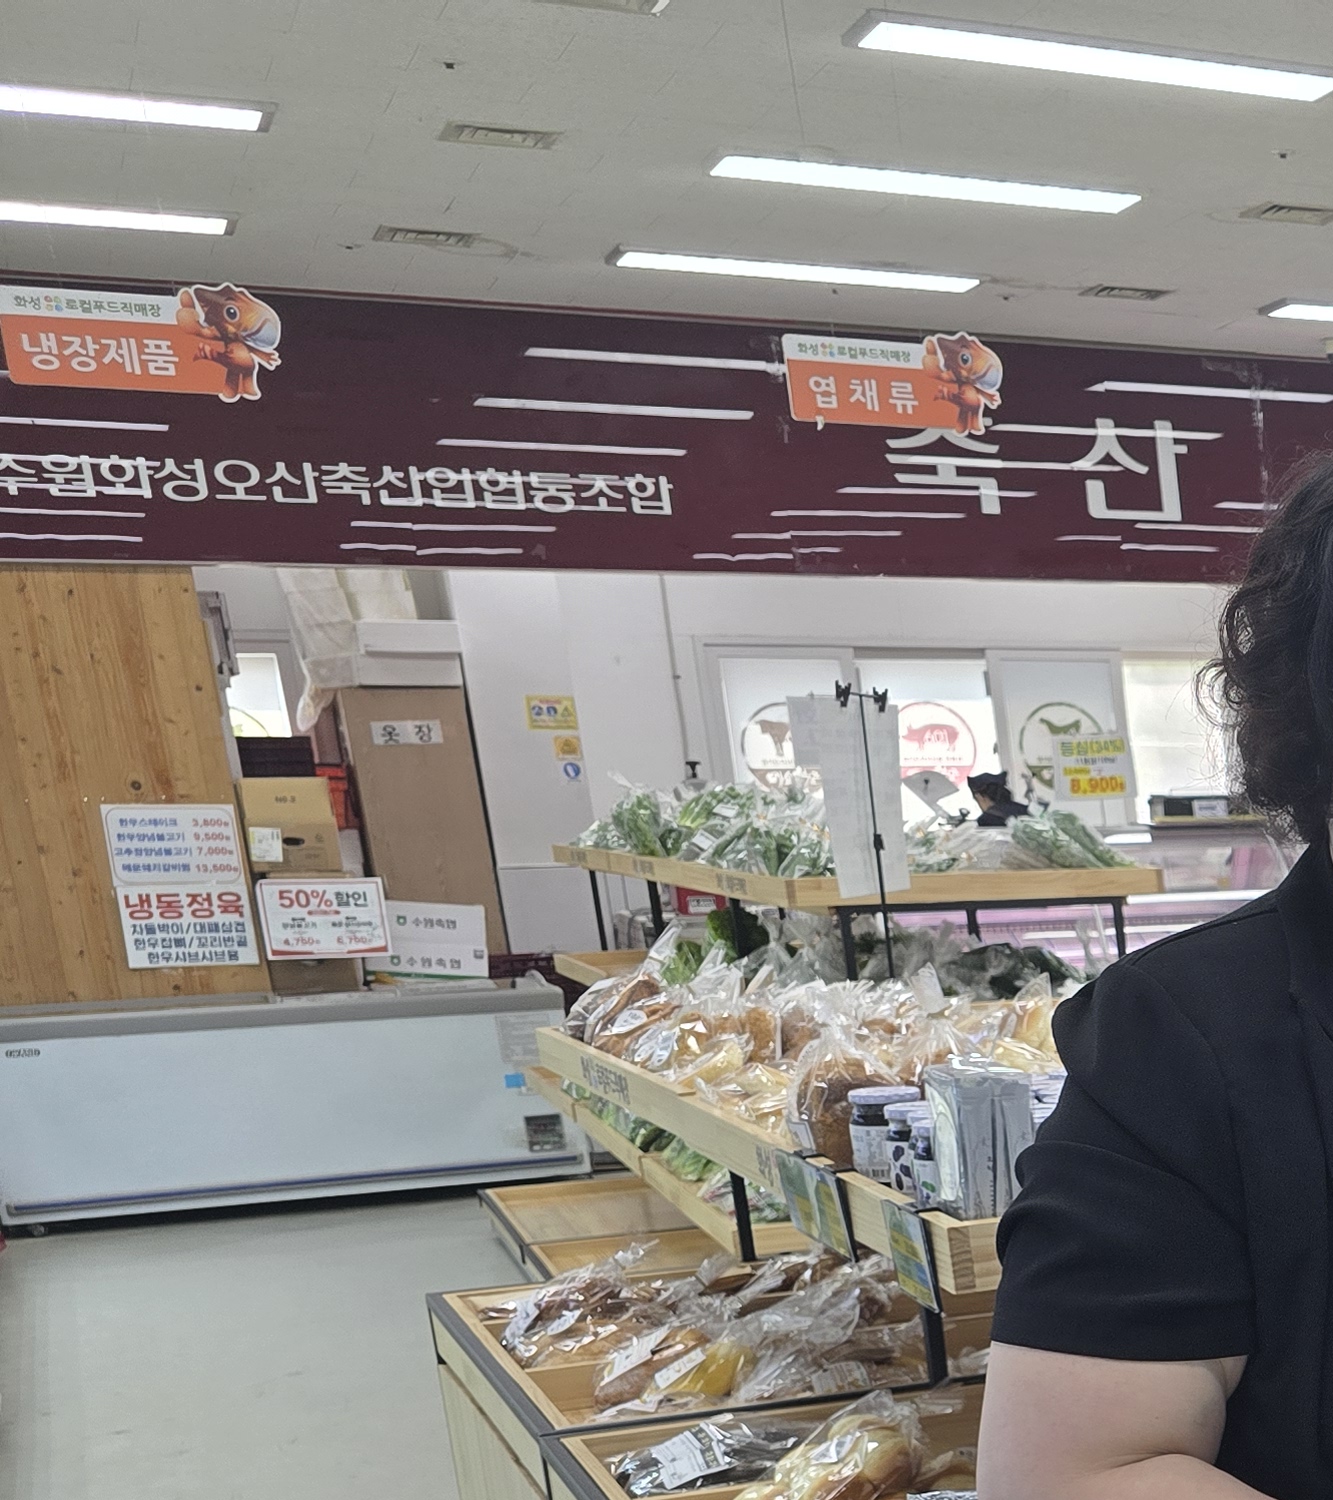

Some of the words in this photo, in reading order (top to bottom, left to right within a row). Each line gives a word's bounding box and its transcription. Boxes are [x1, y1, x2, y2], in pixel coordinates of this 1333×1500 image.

[13, 294, 42, 311] 화성
[65, 297, 162, 318] 로컬푸드직매장
[20, 332, 179, 376] 냉장제품
[797, 342, 819, 357] 화성
[808, 375, 919, 415] 엽채류
[124, 891, 244, 920] 냉동정육
[278, 889, 333, 909] 50%
[334, 891, 369, 908] 할인
